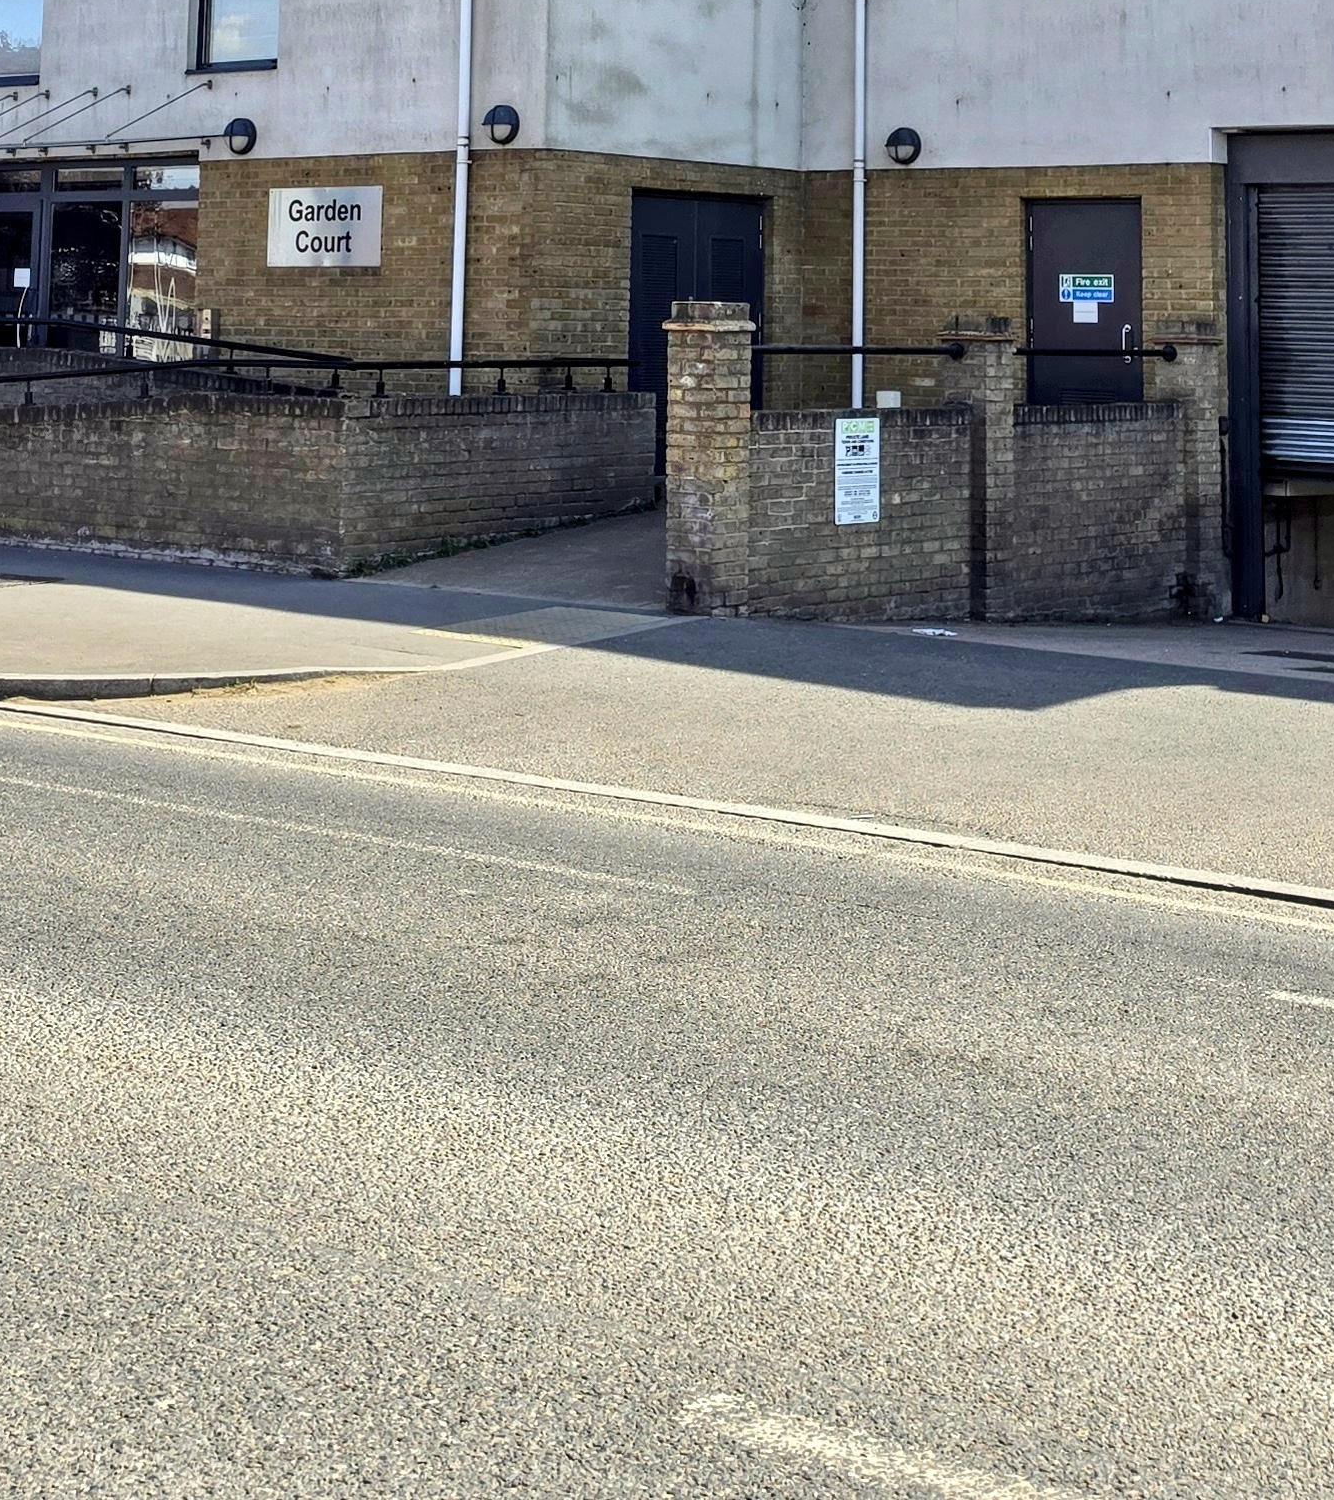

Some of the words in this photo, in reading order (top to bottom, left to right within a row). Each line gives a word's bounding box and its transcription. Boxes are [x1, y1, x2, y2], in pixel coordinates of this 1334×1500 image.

[288, 199, 362, 222] Garden
[295, 230, 352, 253] Court
[1075, 277, 1091, 286] Fire
[1093, 277, 1109, 286] exit
[1075, 290, 1092, 298] Keep
[1093, 290, 1109, 298] clear
